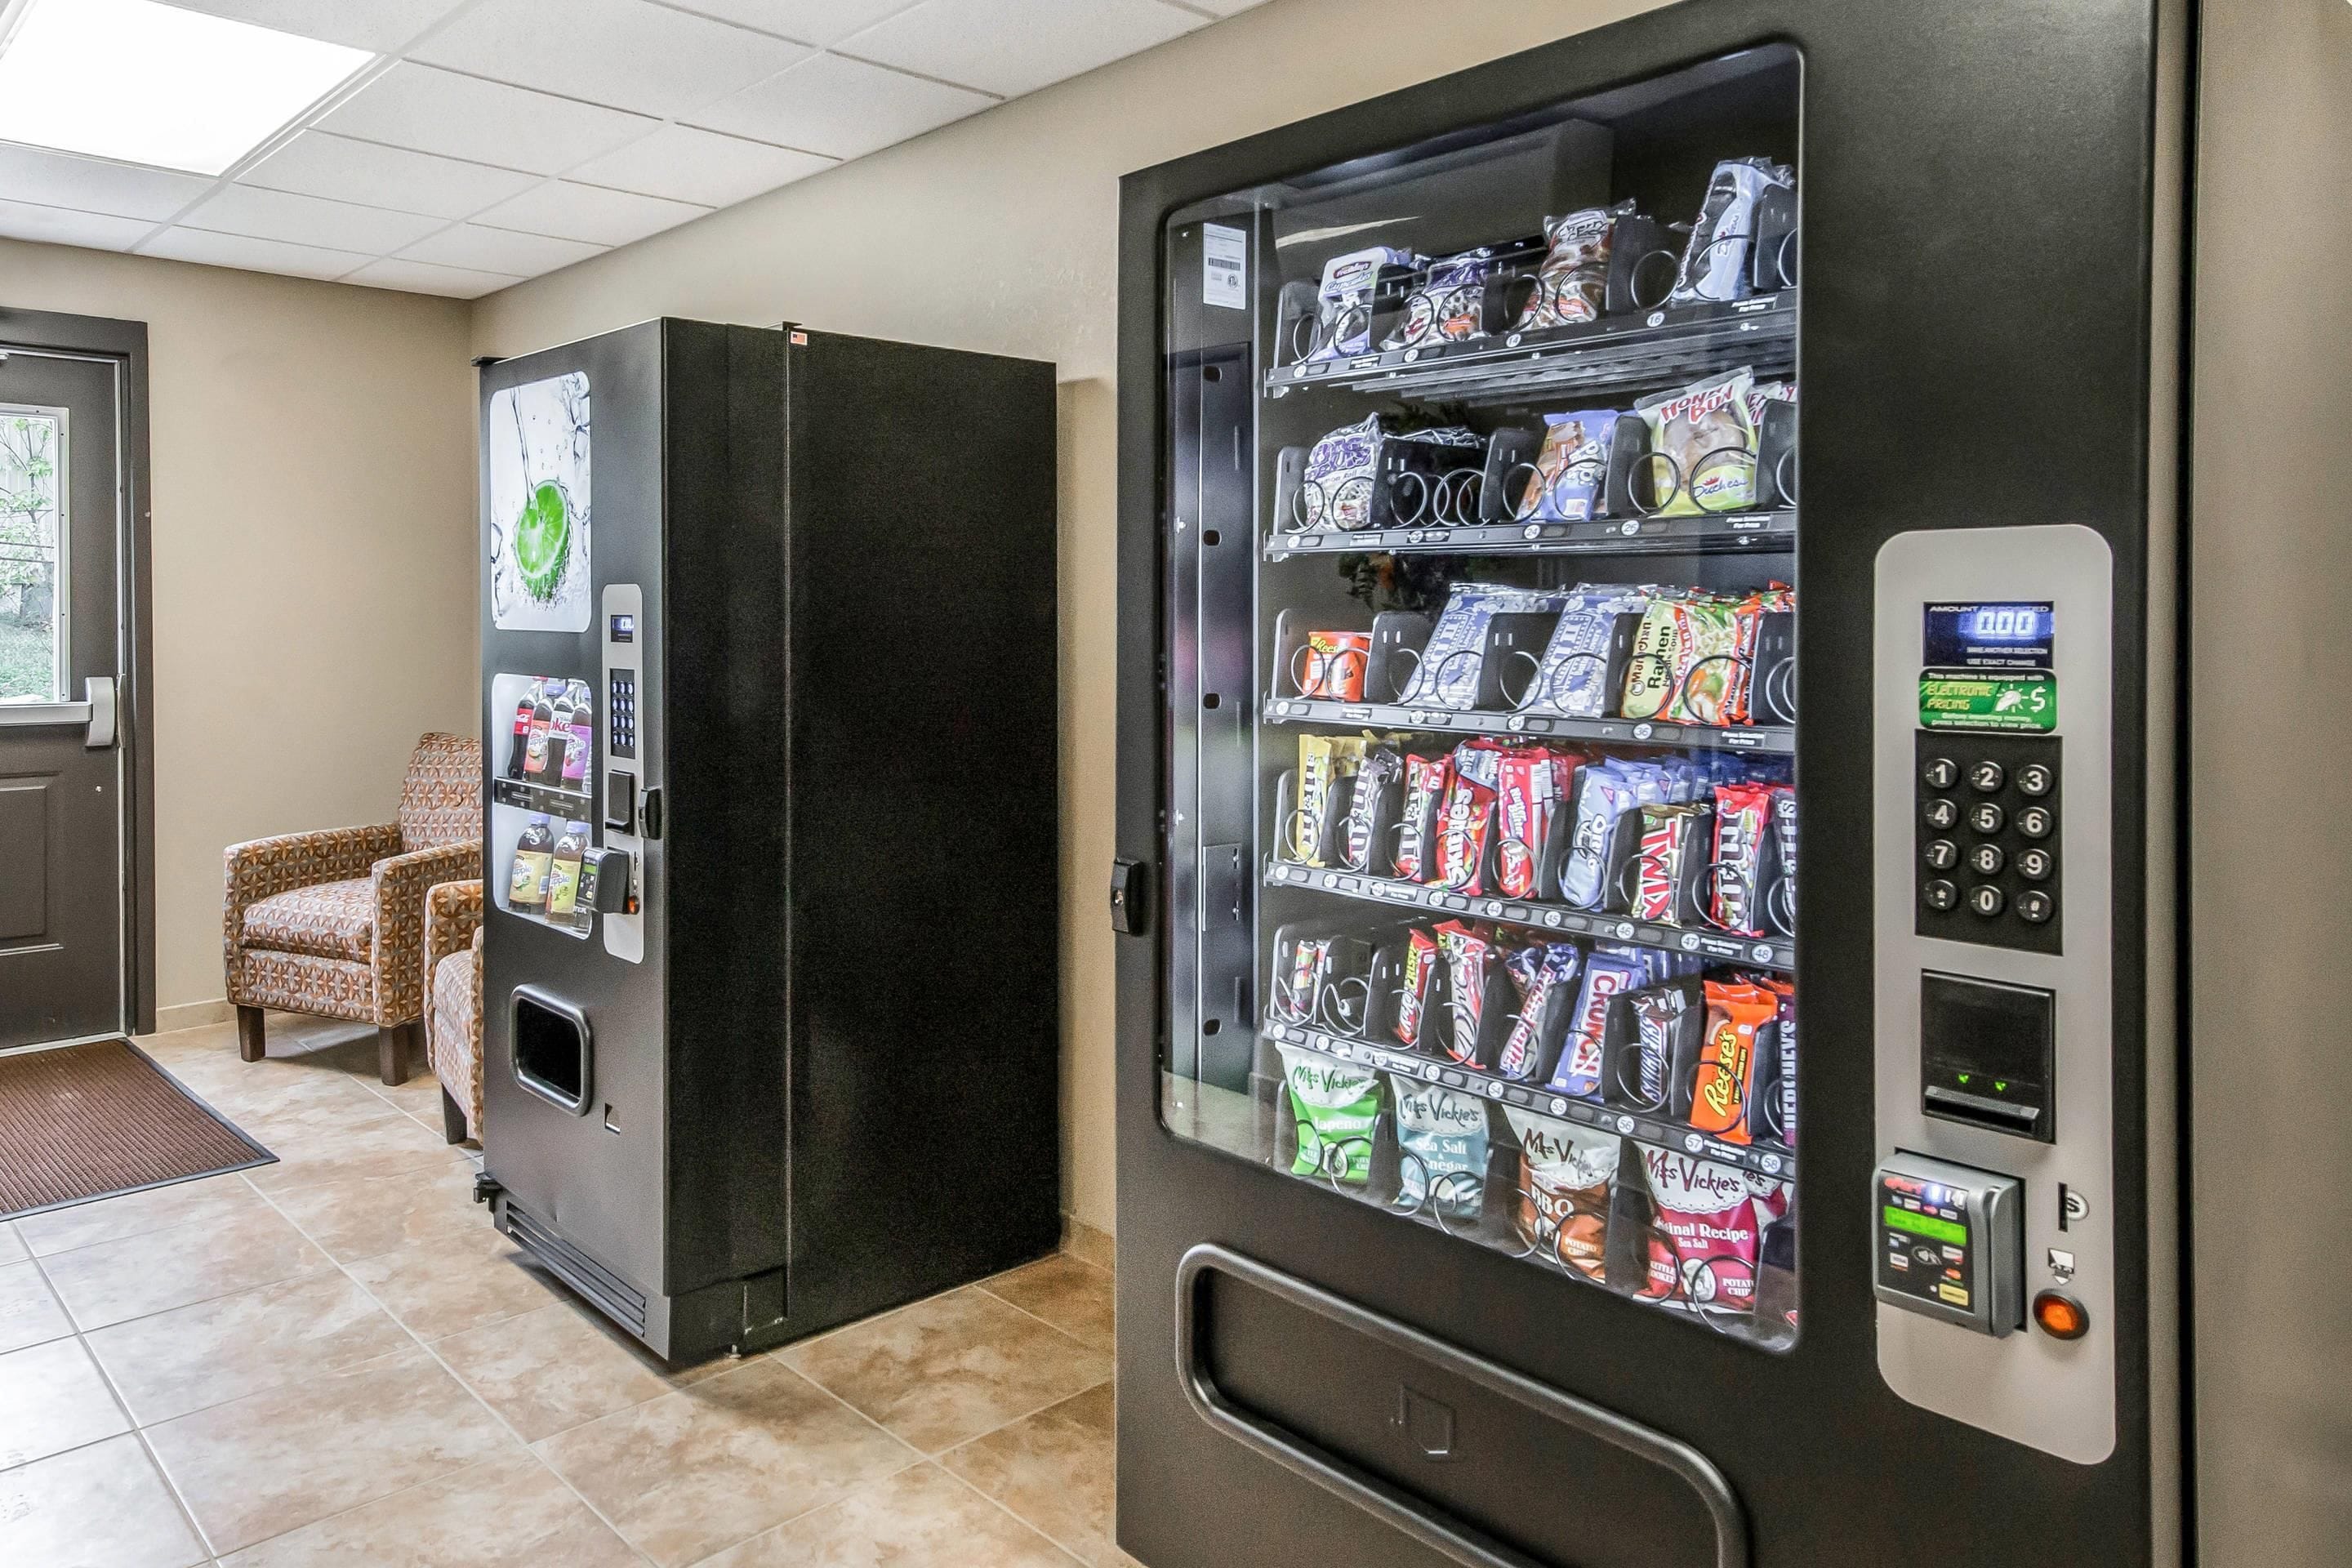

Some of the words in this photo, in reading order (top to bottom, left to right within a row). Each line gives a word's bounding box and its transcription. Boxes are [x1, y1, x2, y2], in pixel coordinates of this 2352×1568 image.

[1650, 314, 1661, 325] 16
[1660, 385, 1724, 423] HONEY
[1690, 385, 1734, 424] BUN
[1693, 480, 1749, 498] Duchess
[1526, 528, 1538, 537] 24
[1624, 523, 1636, 532] 26
[1976, 611, 2036, 636] 0.00
[1316, 639, 1344, 653] Rees
[1631, 621, 1652, 683] Marchan
[1647, 626, 1672, 689] Ramen
[1927, 684, 1993, 697] ELECTRONIC
[1927, 698, 1971, 710] PRICING
[550, 717, 571, 733] oke
[1636, 727, 1649, 737] 36
[1935, 764, 1947, 784] 1
[1980, 767, 1994, 786] 2
[2026, 770, 2042, 791] 3
[1934, 804, 1950, 825] 4
[1979, 808, 1994, 829] 5
[2025, 812, 2042, 834] 6
[1444, 788, 1473, 887] Skittles
[1934, 845, 1949, 865] 7
[1980, 849, 1994, 870] 8
[2026, 854, 2042, 875] 9
[1640, 817, 1677, 920] TWIX
[1980, 890, 1993, 911] 0
[1546, 913, 1559, 924] 45
[1619, 925, 1632, 936] 46
[1683, 936, 1696, 947] 47
[1755, 947, 1769, 959] 48
[1640, 1018, 1662, 1102] SNICKERS
[1704, 1030, 1738, 1117] Reese's
[1489, 1085, 1502, 1095] 54
[1429, 1092, 1480, 1128] Vickie's
[1552, 1102, 1566, 1112] 55
[1619, 1119, 1633, 1129] 56
[1415, 1138, 1438, 1152] Sea
[1442, 1138, 1468, 1155] Salt
[1687, 1137, 1702, 1148] 57
[1423, 1158, 1468, 1173] negar
[1762, 1158, 1778, 1169] 58
[1678, 1156, 1740, 1200] Vickie's
[1653, 1215, 1695, 1237] inal
[1699, 1222, 1750, 1244] Recipe
[1678, 1236, 1694, 1248] Sea
[1695, 1237, 1708, 1250] Salt
[1727, 1286, 1752, 1297] CHIP
